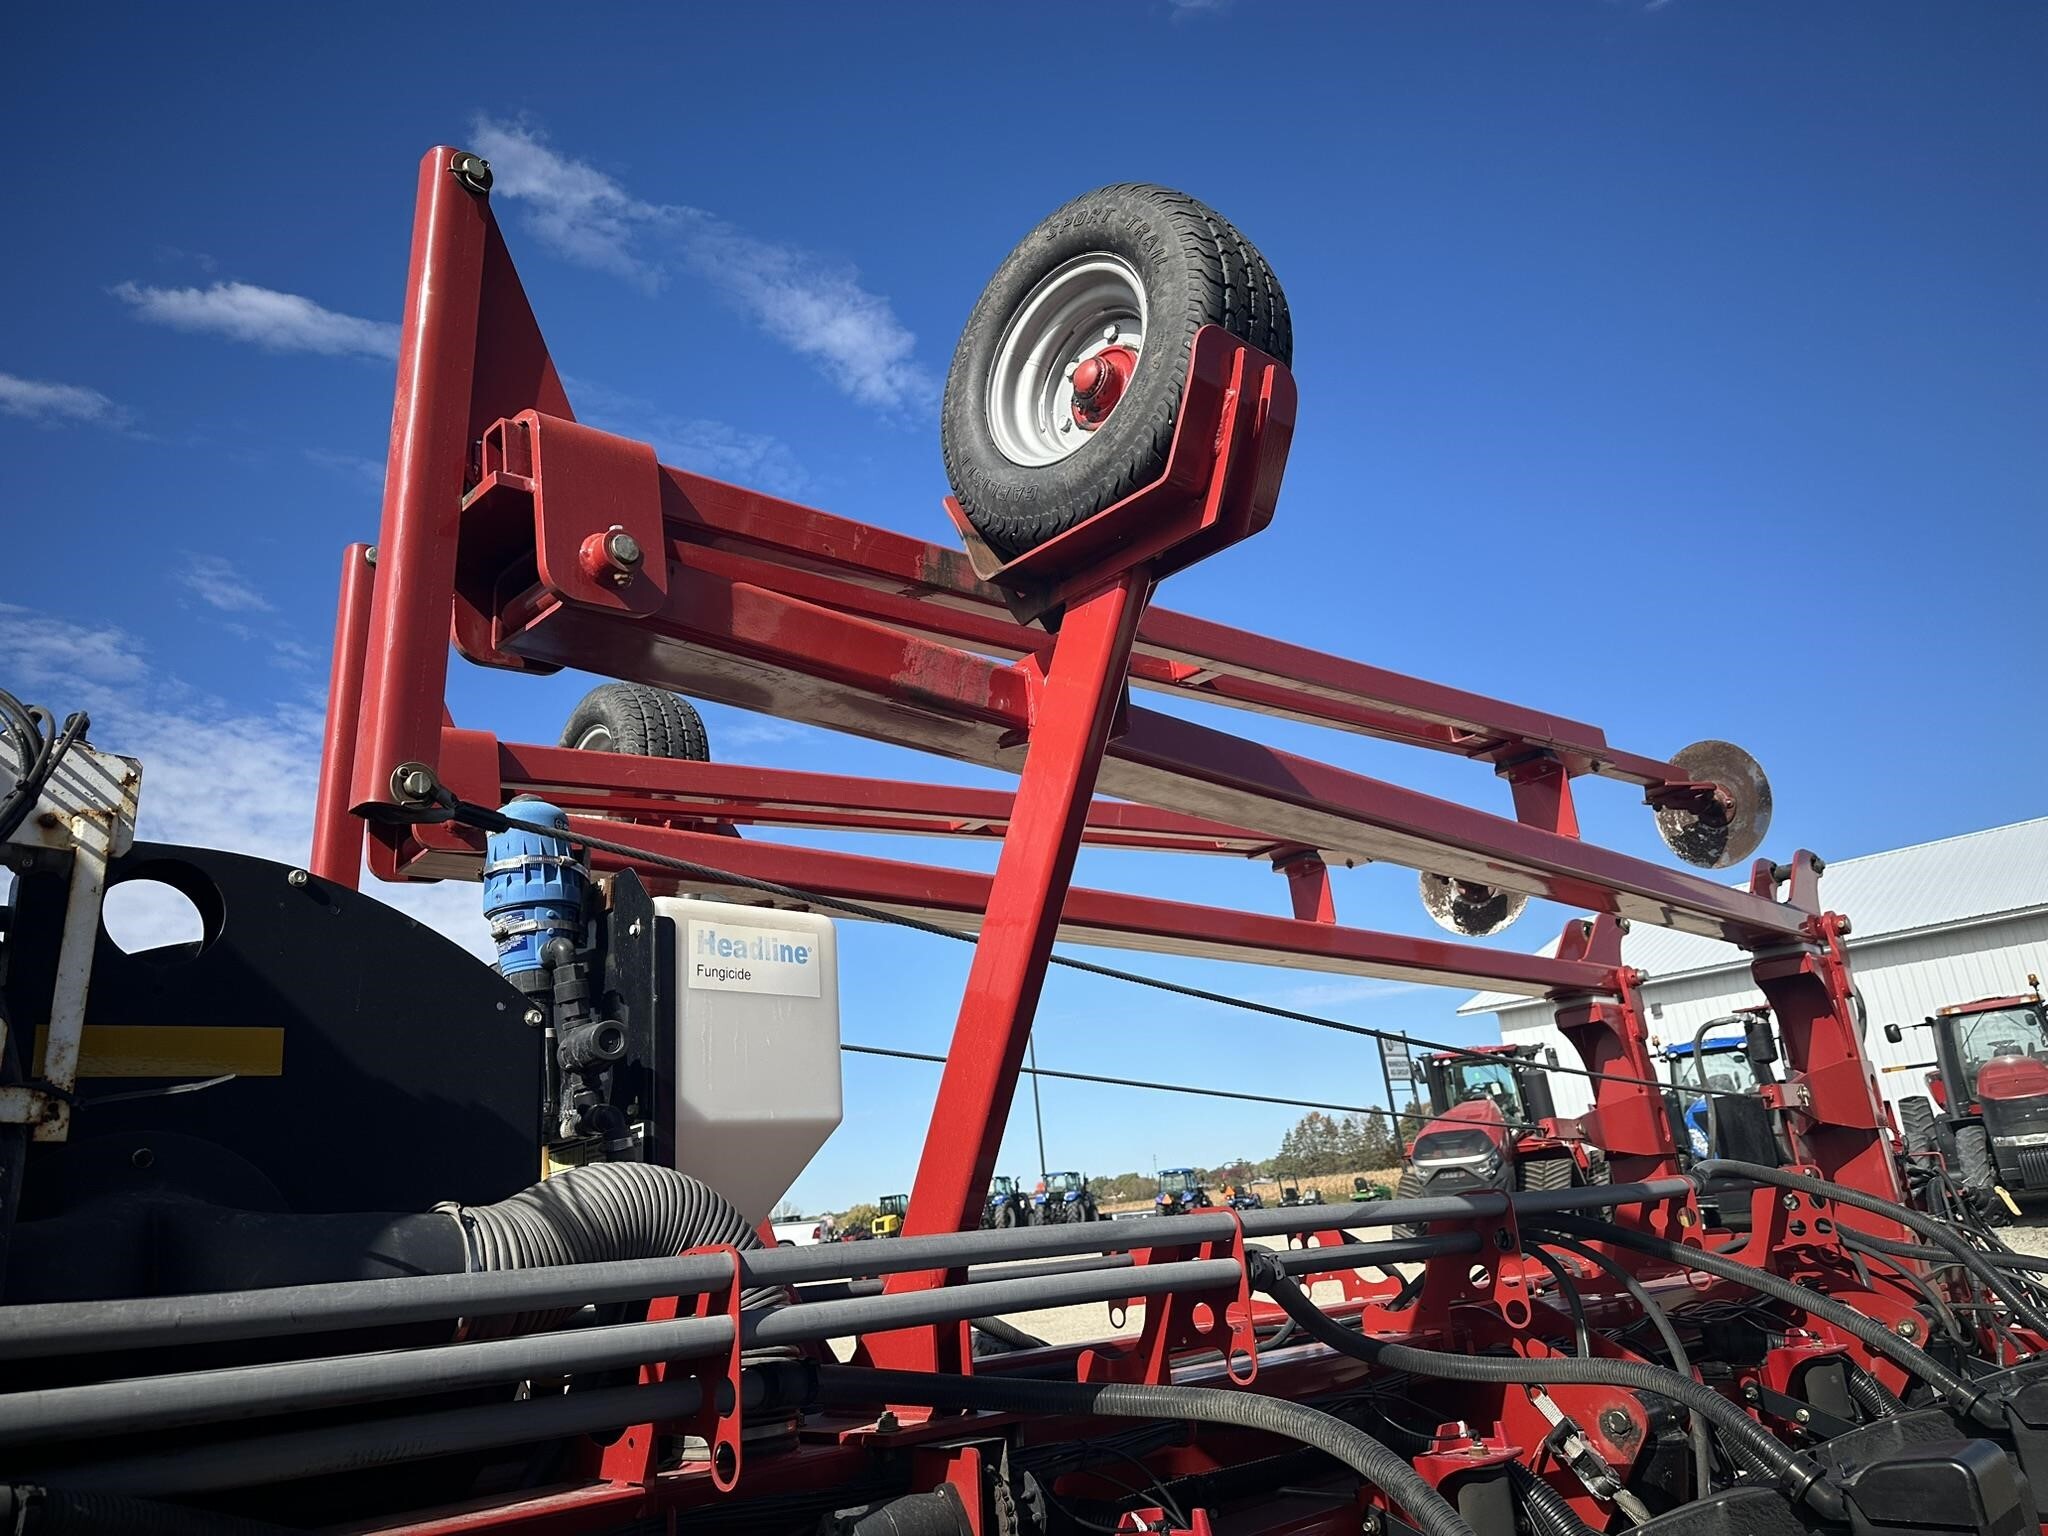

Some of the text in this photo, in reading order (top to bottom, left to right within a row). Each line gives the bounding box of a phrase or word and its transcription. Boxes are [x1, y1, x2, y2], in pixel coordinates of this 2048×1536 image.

[1046, 208, 1169, 274] SPORT TRAIL
[697, 929, 809, 965] Headline
[696, 964, 752, 982] Fungicide
